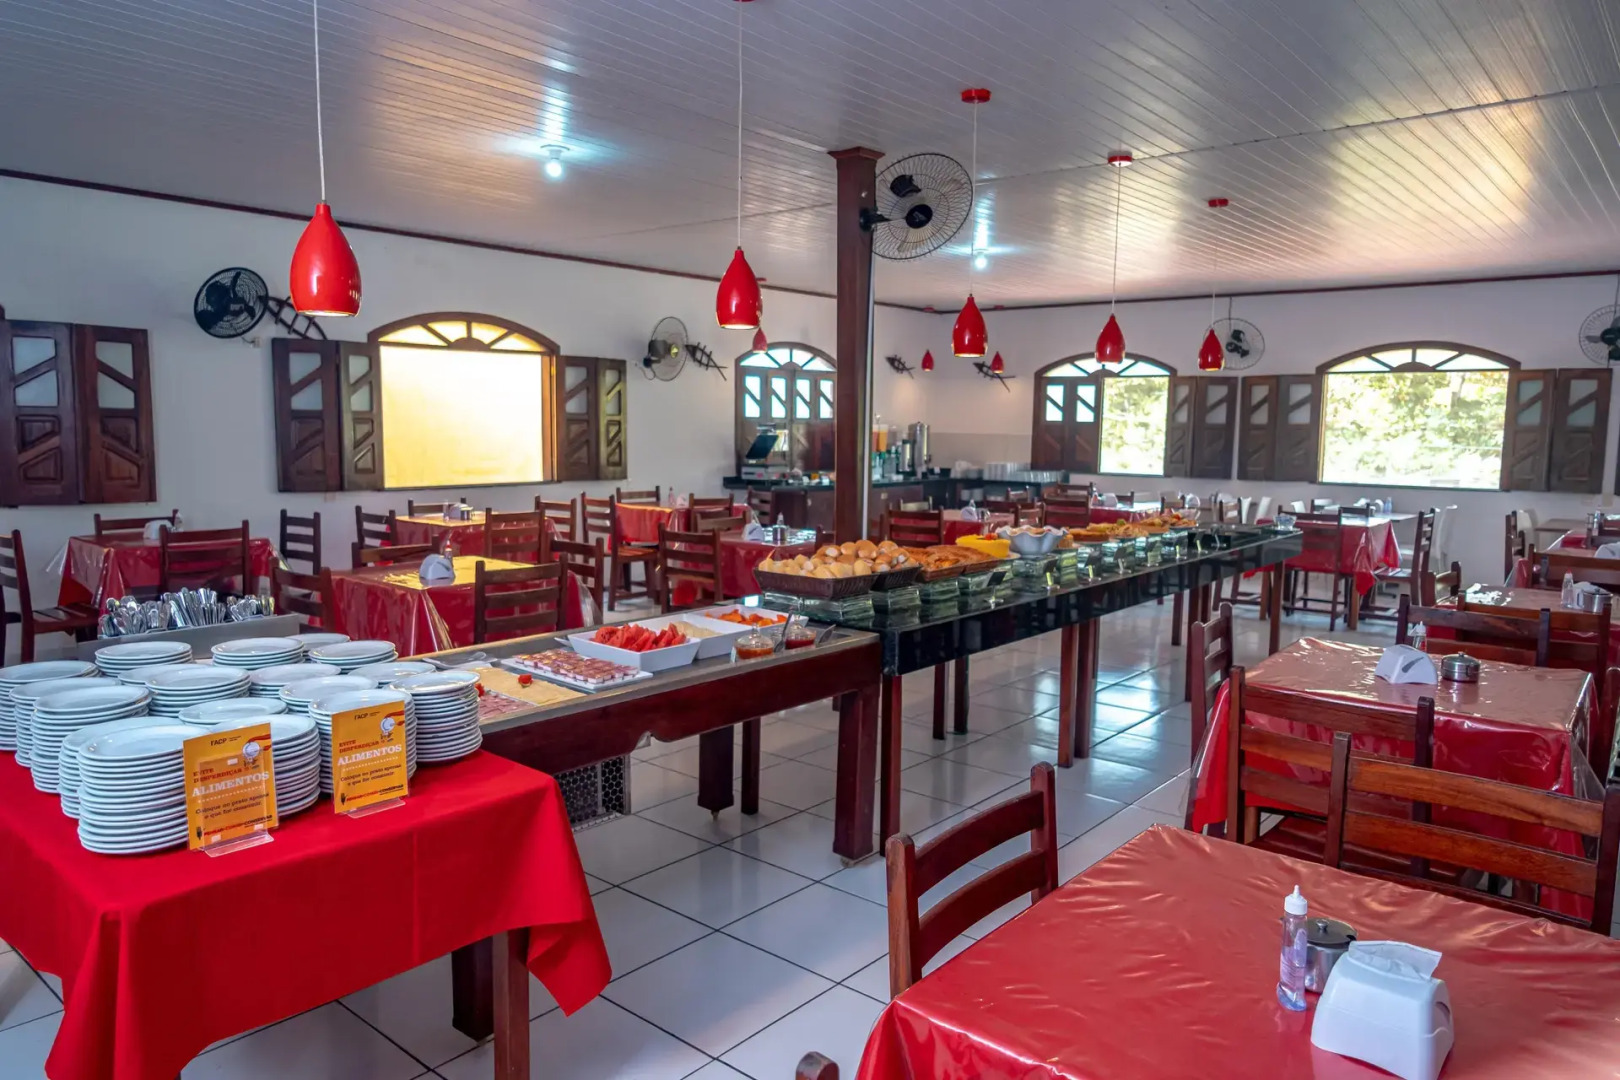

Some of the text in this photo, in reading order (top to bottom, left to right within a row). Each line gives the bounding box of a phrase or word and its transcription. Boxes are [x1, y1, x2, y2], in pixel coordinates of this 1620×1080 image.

[339, 739, 356, 747] EVITE
[337, 744, 402, 766] ALIMENTOS
[192, 771, 269, 797] ALIMENTOS
